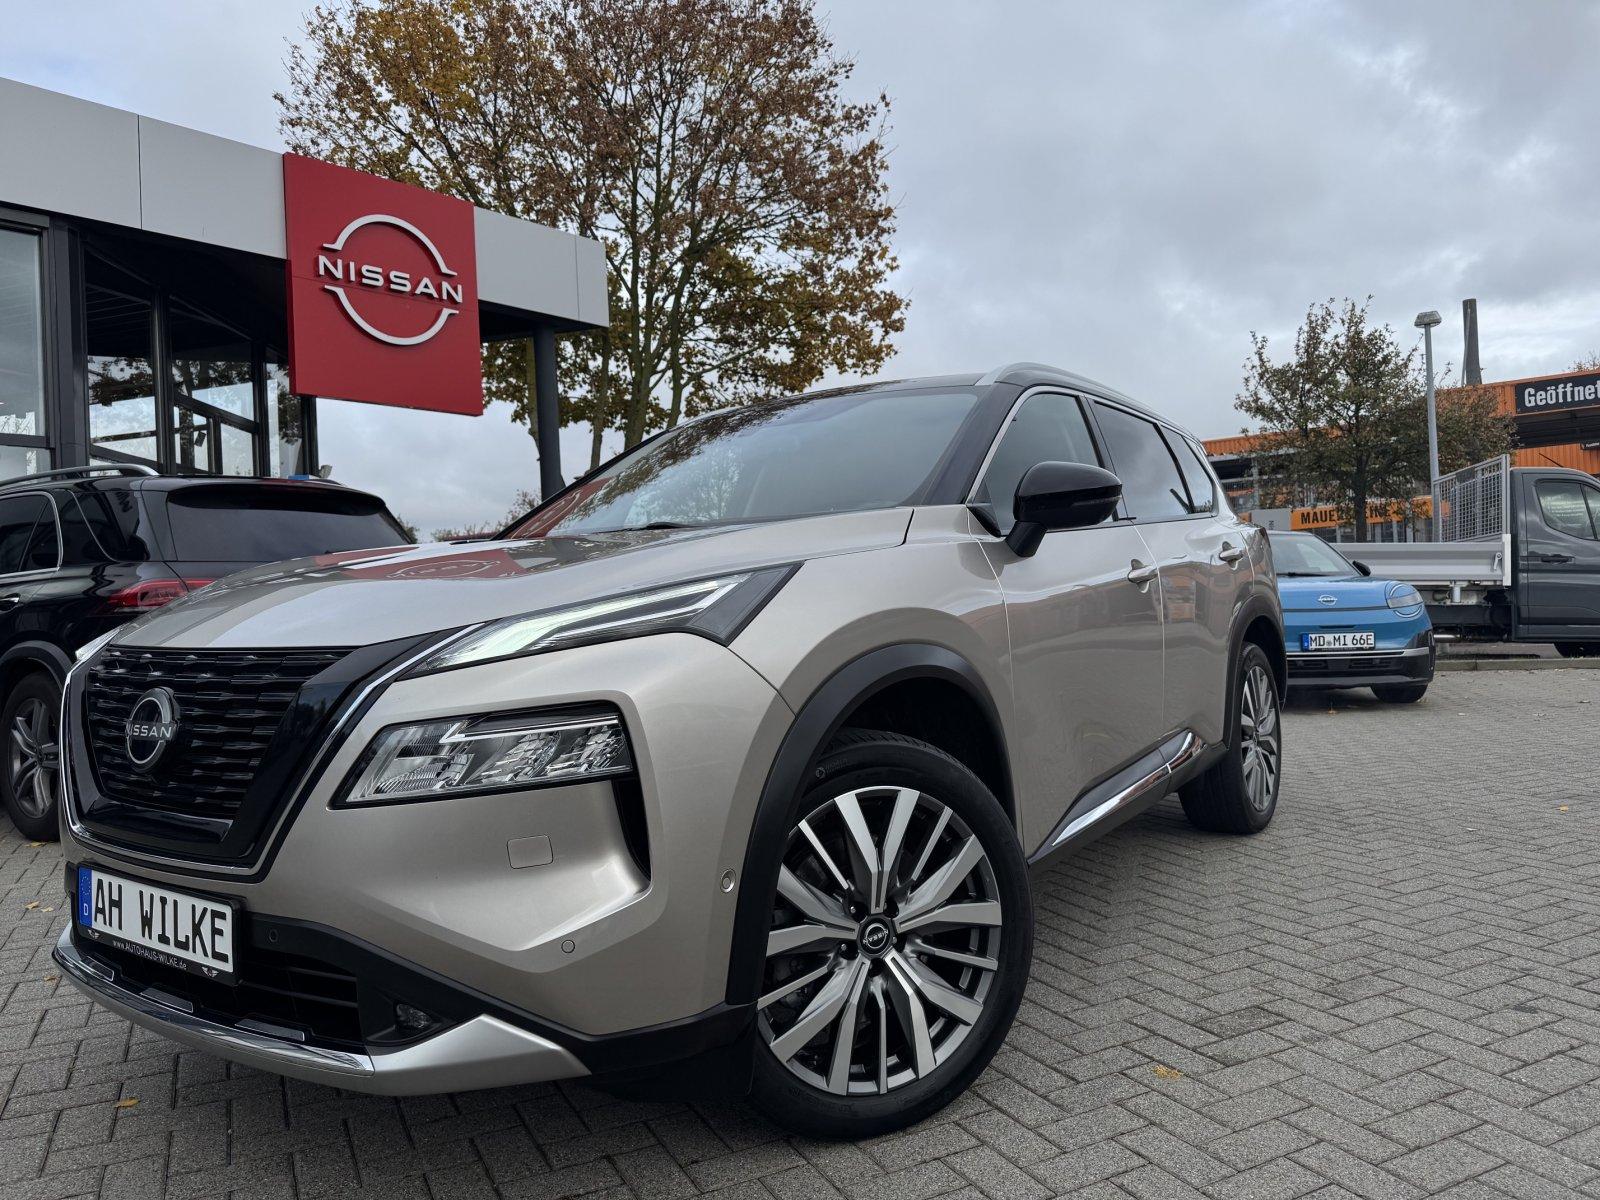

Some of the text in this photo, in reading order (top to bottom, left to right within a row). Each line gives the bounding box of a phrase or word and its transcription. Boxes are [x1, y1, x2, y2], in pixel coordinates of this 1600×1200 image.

[318, 254, 462, 303] NISSAN
[1524, 380, 1600, 407] Geöffnet
[94, 878, 229, 964] AH WILKE
